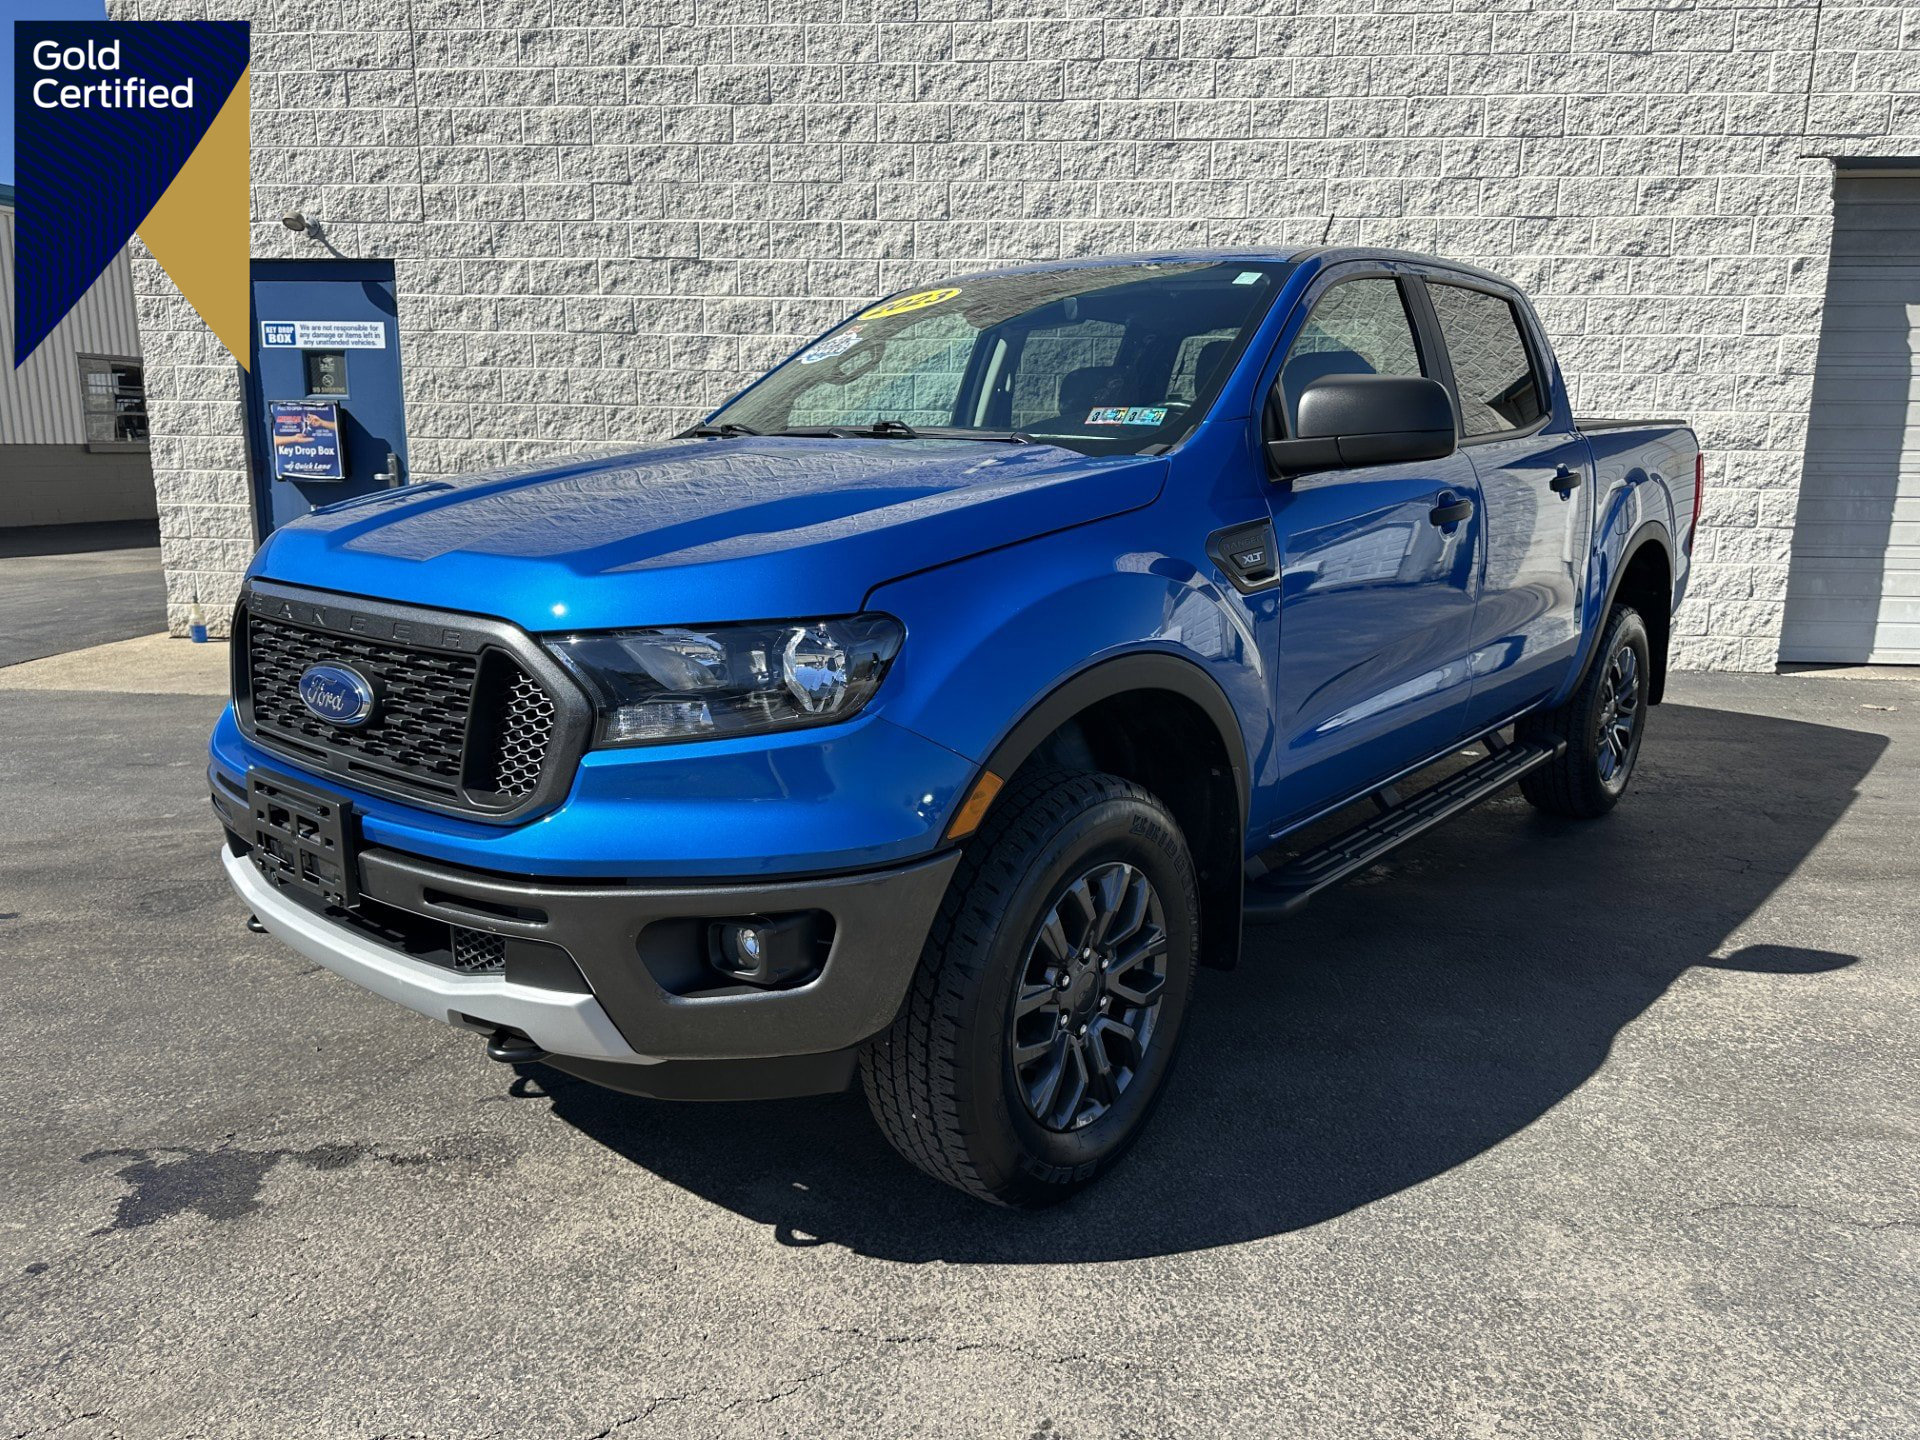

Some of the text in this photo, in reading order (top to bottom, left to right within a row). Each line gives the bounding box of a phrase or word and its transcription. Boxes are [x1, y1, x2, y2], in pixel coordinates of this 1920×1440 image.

[268, 334, 292, 343] BOX
[1092, 411, 1101, 421] 3
[1128, 411, 1137, 421] 3
[278, 445, 335, 457] Key Drop Box
[294, 462, 313, 470] Quick
[1242, 551, 1263, 565] XLT
[249, 590, 463, 648] RANGER
[306, 674, 346, 712] Ford
